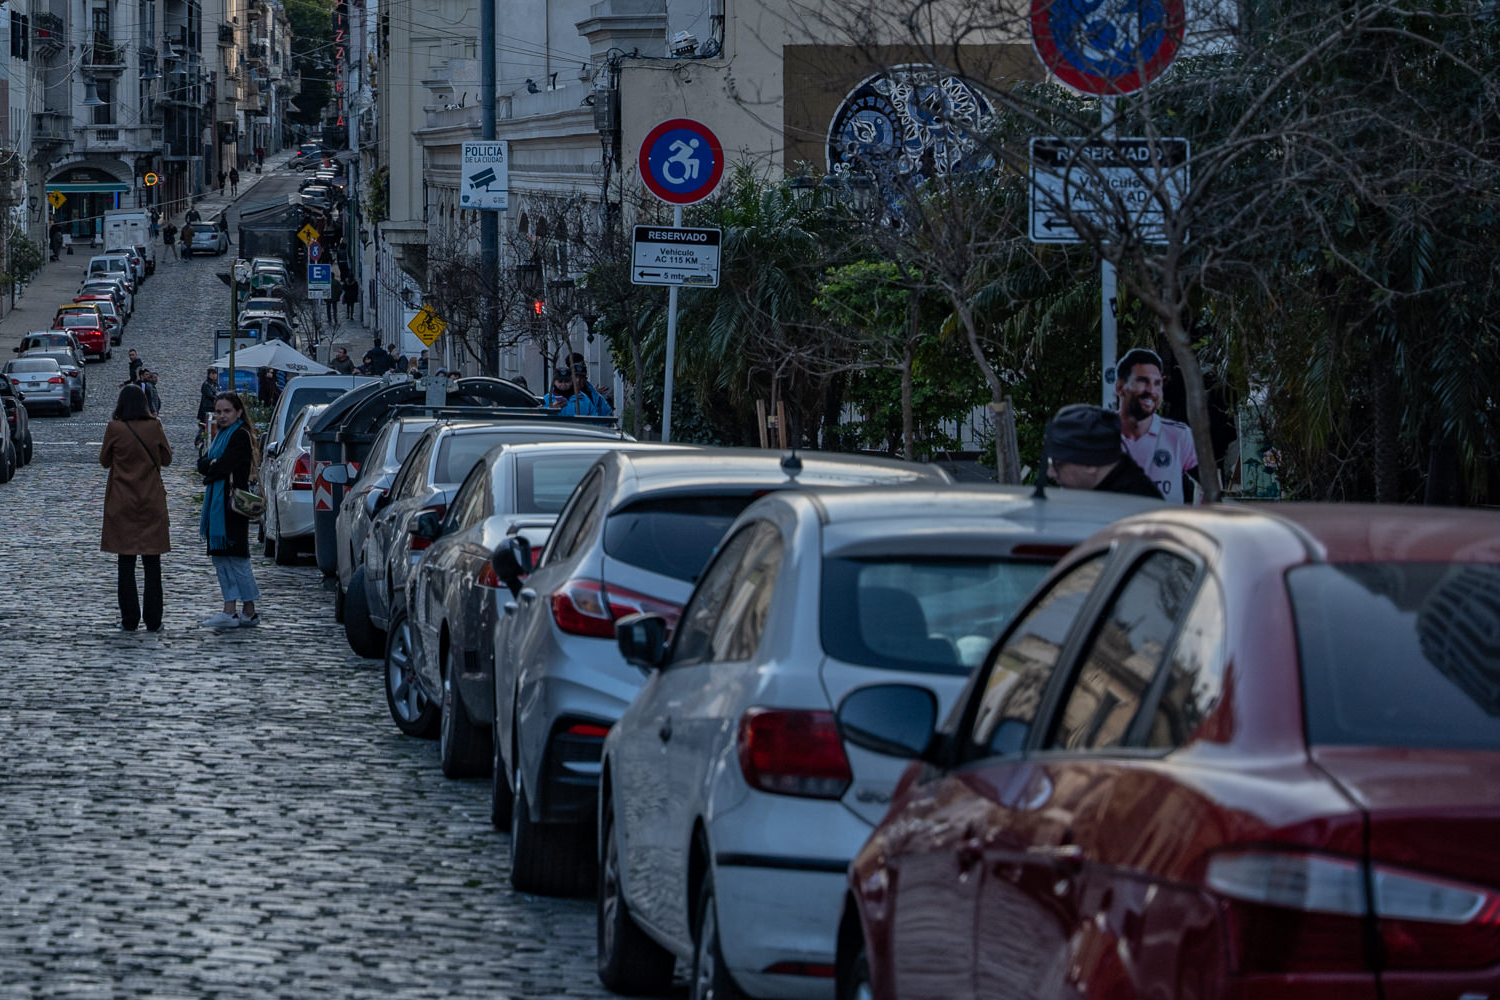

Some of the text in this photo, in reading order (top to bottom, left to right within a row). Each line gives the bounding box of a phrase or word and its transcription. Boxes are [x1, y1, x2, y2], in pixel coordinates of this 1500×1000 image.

[465, 146, 503, 156] POLICIA
[648, 231, 708, 242] RESERVADO
[655, 255, 698, 265] AC 115 KM
[313, 266, 322, 279] E
